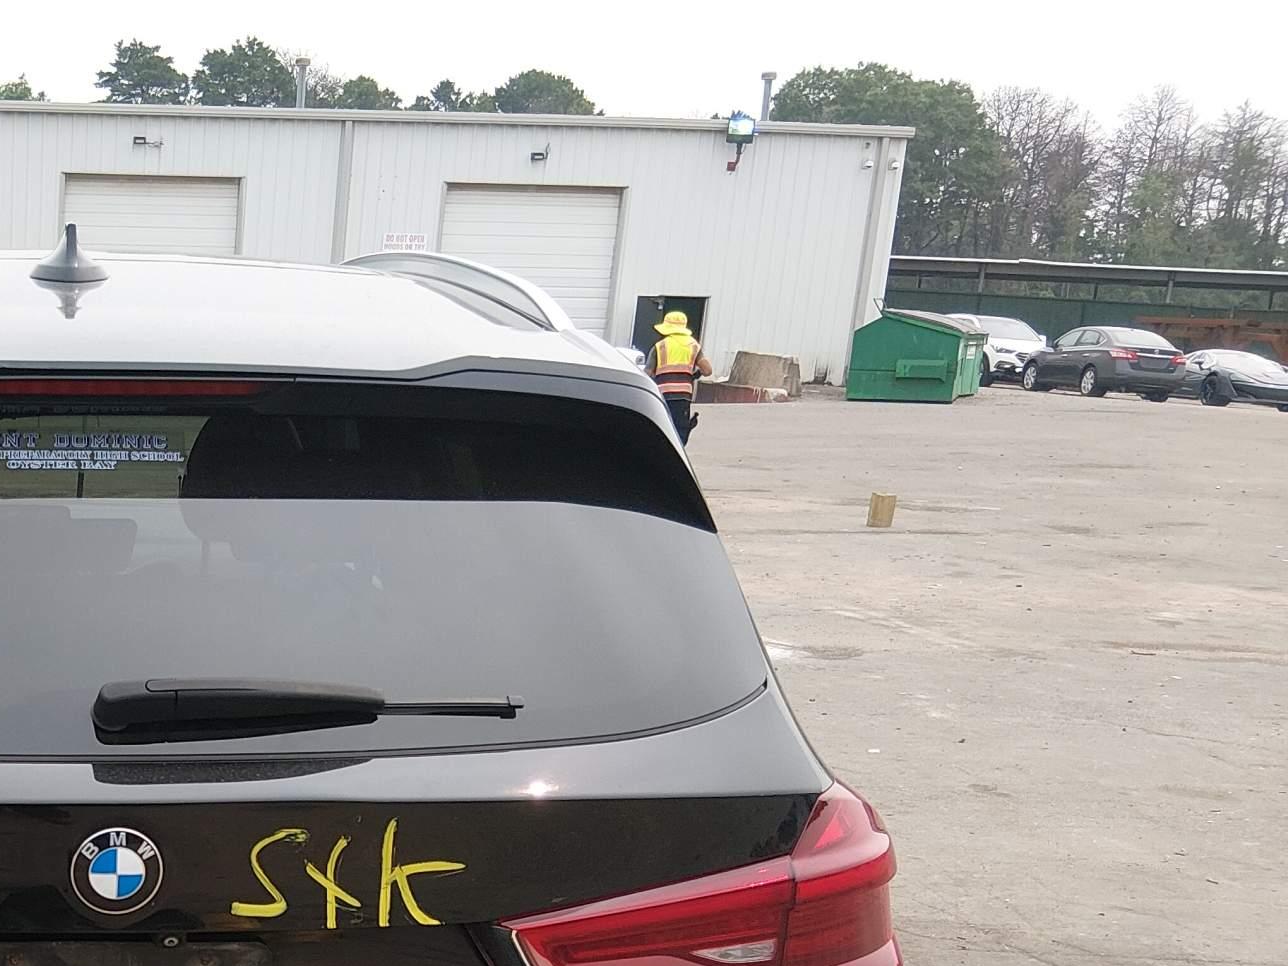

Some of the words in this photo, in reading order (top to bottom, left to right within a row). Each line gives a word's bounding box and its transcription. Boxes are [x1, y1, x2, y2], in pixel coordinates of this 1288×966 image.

[385, 234, 394, 242] DO
[396, 234, 408, 242] NOT
[409, 234, 424, 243] OPEN
[53, 433, 168, 450] DOMINIC
[0, 450, 92, 460] PREPARATORY
[93, 451, 129, 461] HIGH
[130, 451, 185, 462] SCHOOL
[6, 460, 78, 470] OYSTER
[80, 460, 117, 470] BAY
[81, 832, 155, 860] BMW
